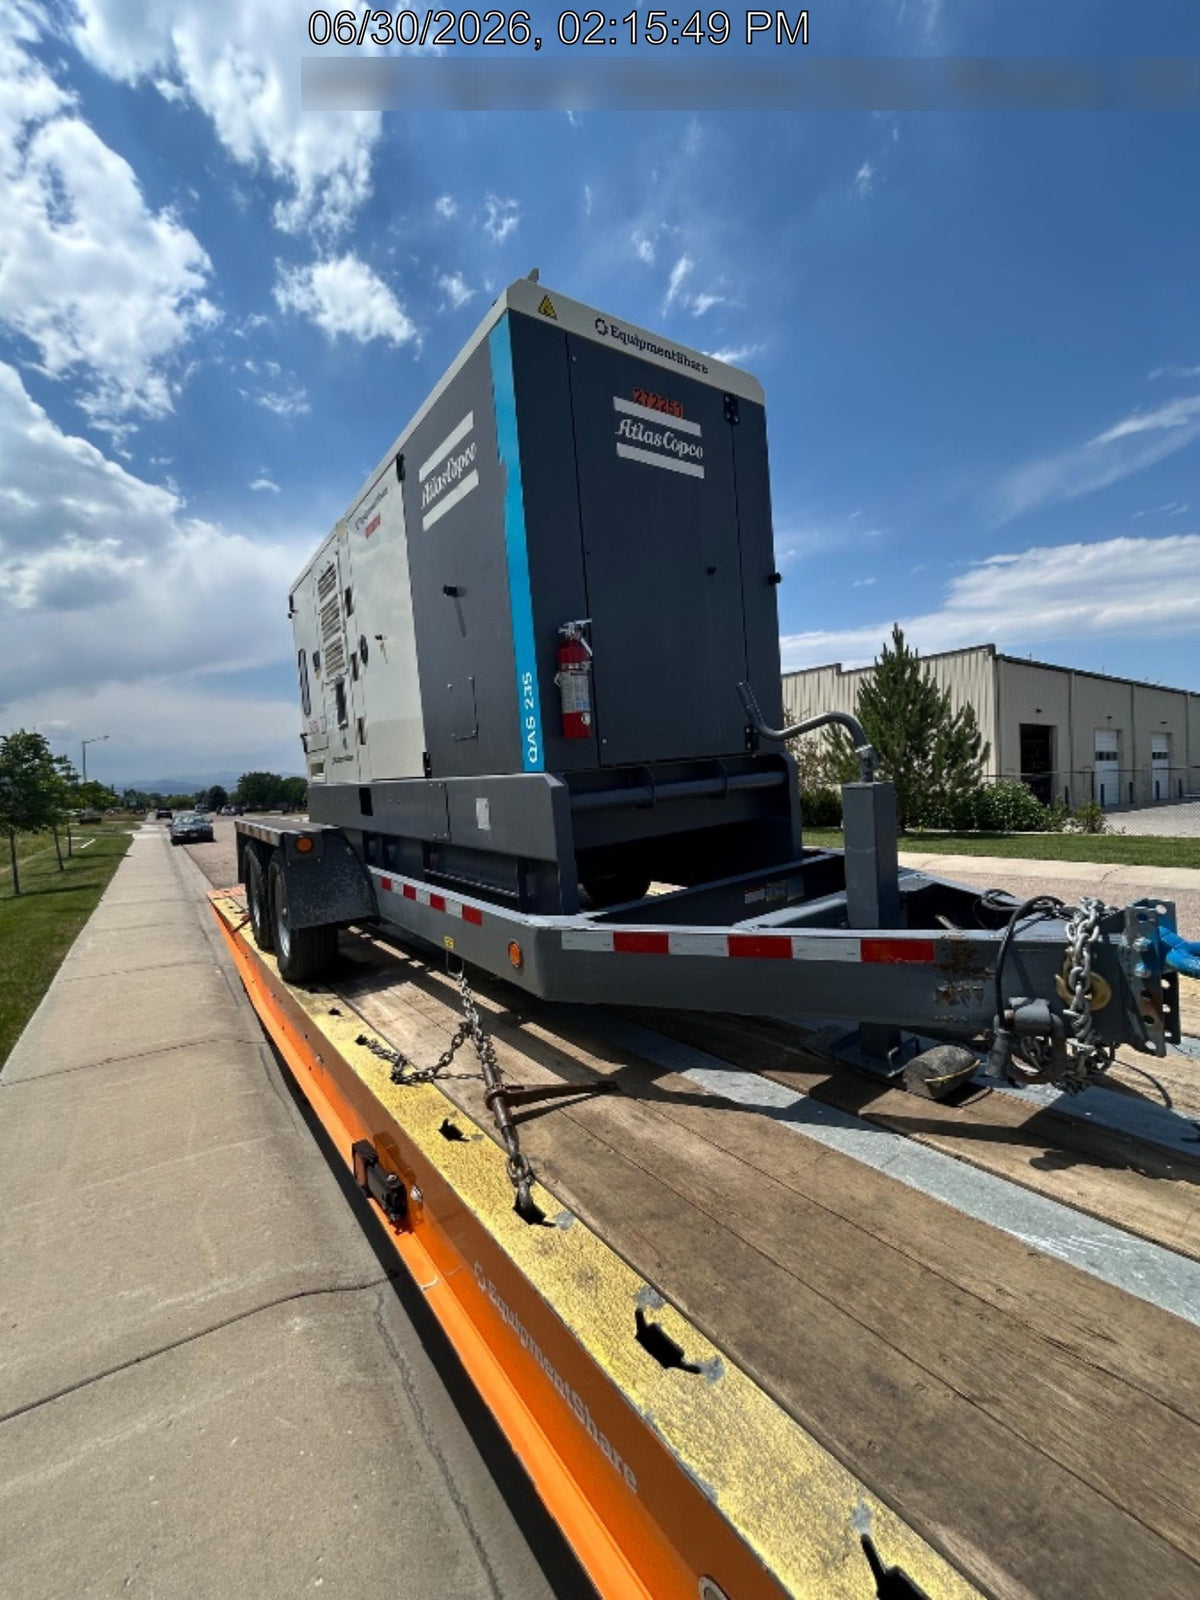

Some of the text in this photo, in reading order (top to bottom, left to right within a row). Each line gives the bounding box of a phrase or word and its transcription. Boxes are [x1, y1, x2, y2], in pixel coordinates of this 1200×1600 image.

[522, 672, 538, 763] QAS 235
[488, 1285, 638, 1494] EquipmentShare
